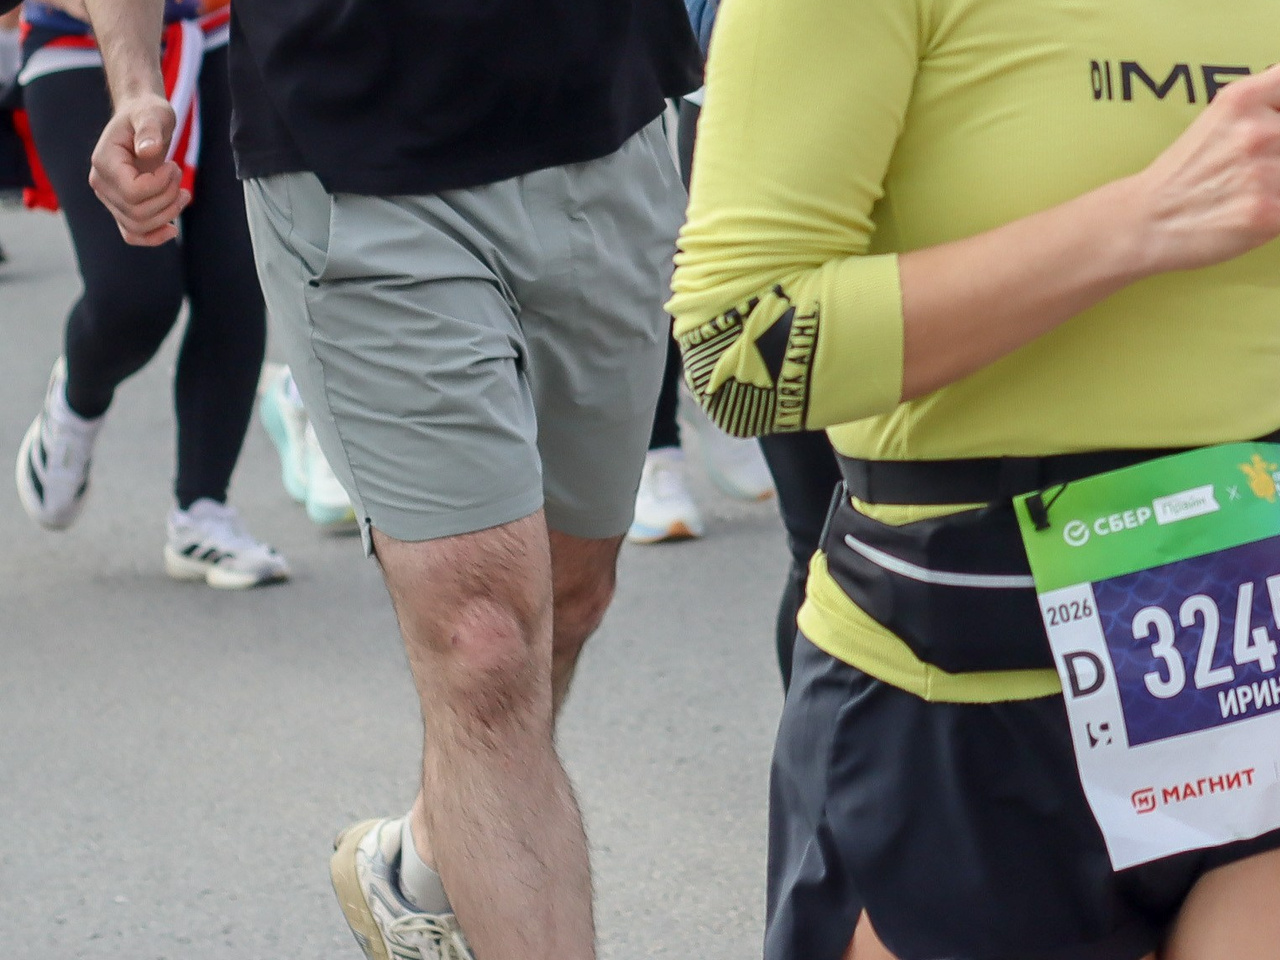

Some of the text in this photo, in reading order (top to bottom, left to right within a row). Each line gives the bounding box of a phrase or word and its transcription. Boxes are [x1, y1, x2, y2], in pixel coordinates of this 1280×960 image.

[1093, 507, 1152, 537] СБЕР
[1046, 598, 1093, 627] 2026
[1062, 650, 1106, 698] D
[1161, 767, 1256, 805] МАГНИТ
